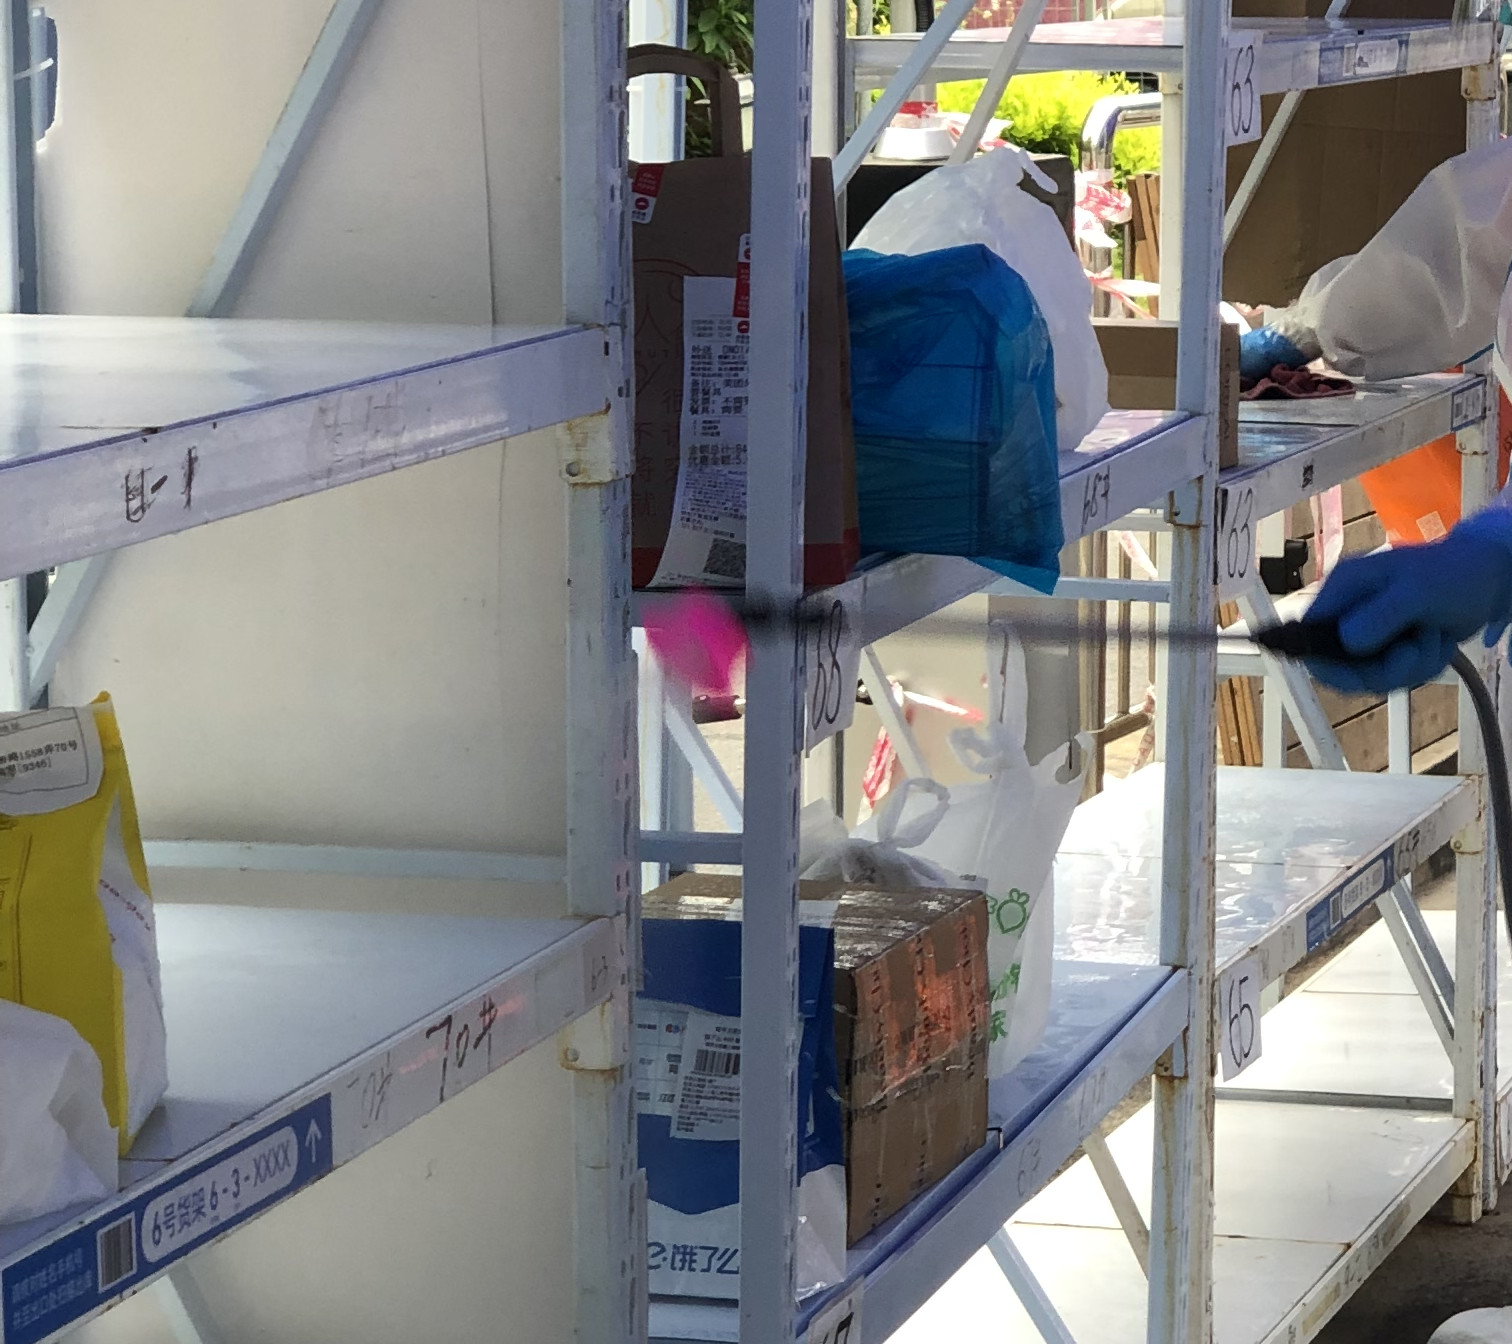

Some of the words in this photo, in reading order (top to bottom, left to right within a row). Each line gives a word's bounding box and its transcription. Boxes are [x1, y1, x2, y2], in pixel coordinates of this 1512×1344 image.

[1230, 44, 1255, 137] 63
[1227, 478, 1253, 579] 63
[812, 599, 844, 731] 68
[1228, 975, 1255, 1068] 65
